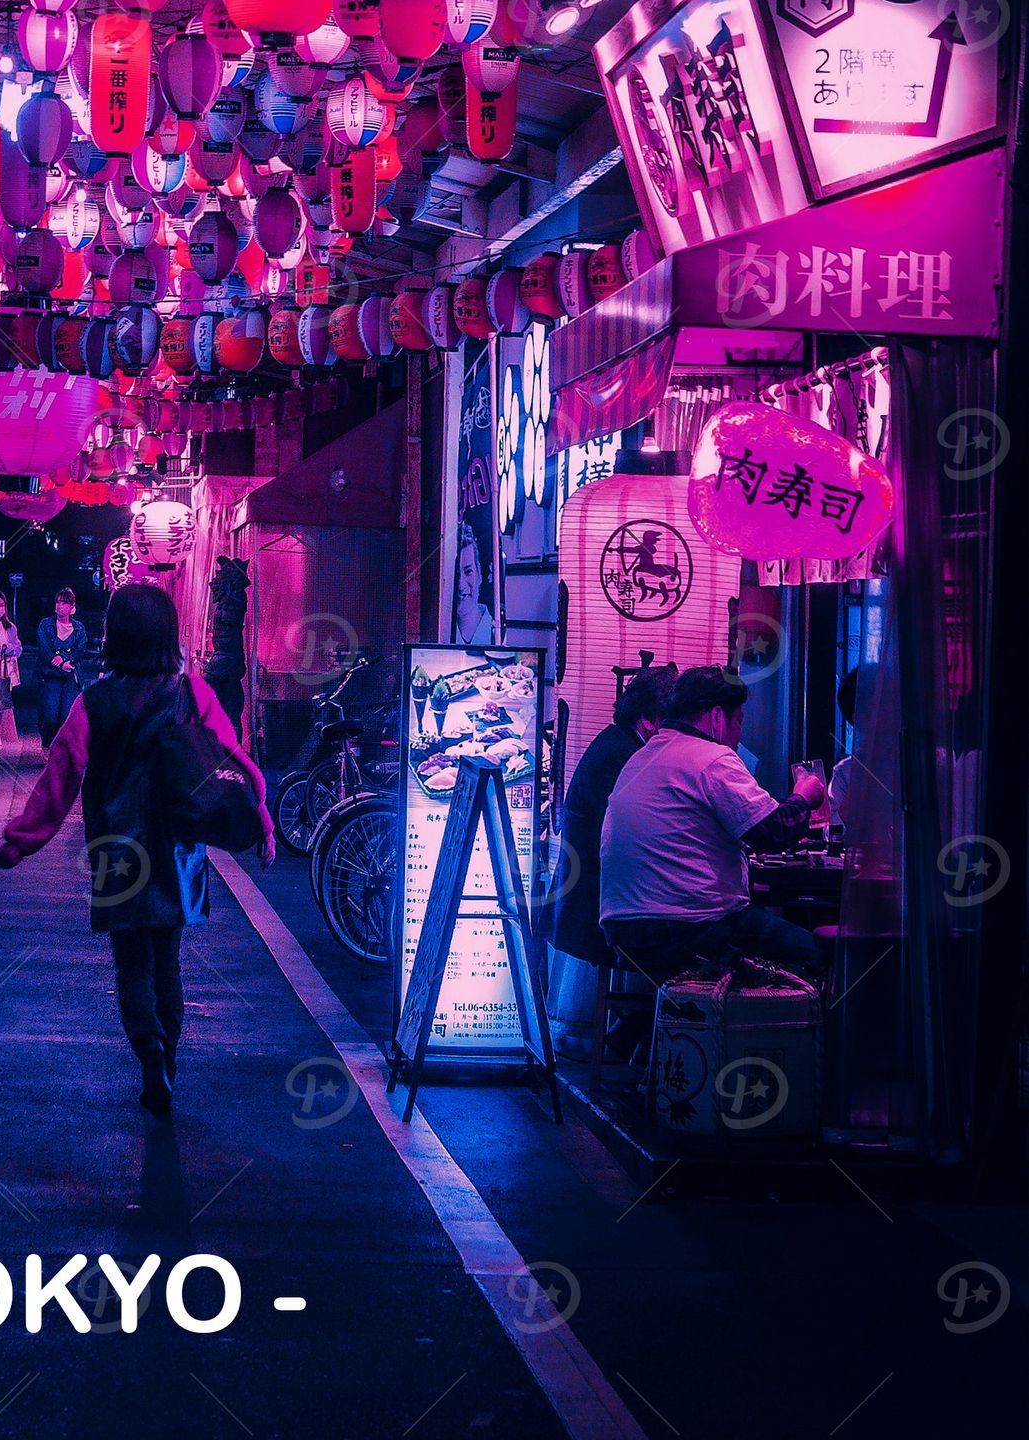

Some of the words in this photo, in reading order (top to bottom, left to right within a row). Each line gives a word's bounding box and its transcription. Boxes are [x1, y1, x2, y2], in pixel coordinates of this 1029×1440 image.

[109, 59, 129, 133] 一番搾り
[349, 86, 359, 129] アサヒビール
[717, 241, 955, 321] 肉料理
[434, 294, 445, 338] キリンビール
[716, 447, 866, 535] 肉寿司
[604, 568, 637, 616] 肉寿司
